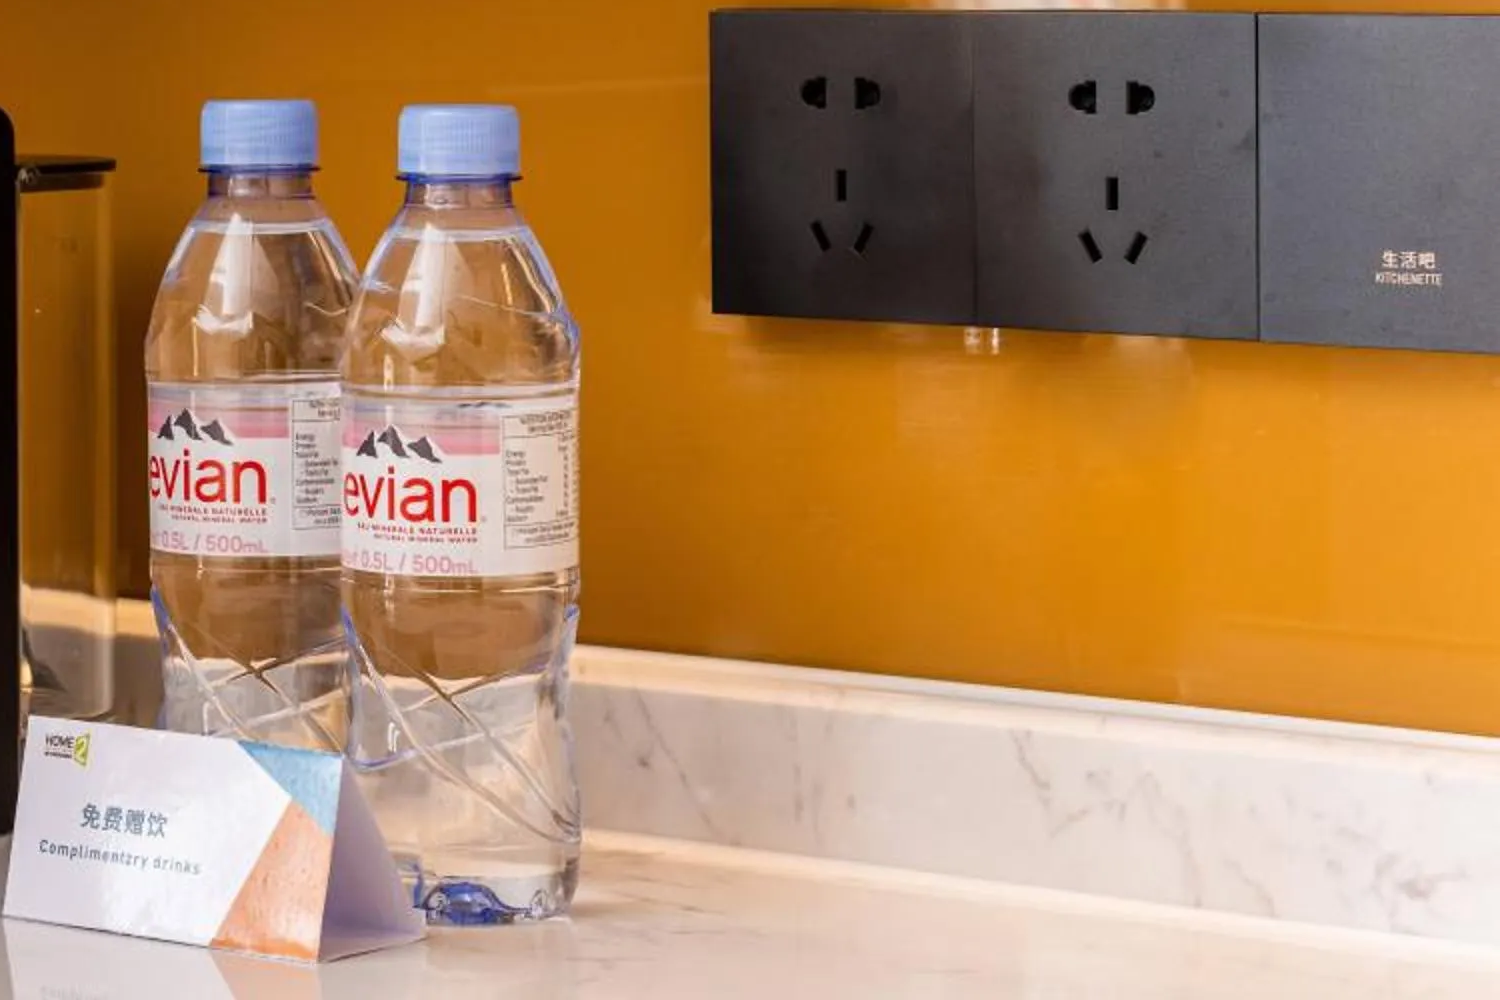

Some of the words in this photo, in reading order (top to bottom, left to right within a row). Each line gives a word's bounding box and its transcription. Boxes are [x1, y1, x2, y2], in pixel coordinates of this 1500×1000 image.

[1381, 250, 1436, 269] 生活吧
[1375, 272, 1443, 285] KITCHENETTE
[149, 448, 267, 504] evian
[343, 465, 477, 522] evian
[211, 506, 267, 516] NATURELLE
[419, 527, 477, 535] NATURELLE
[206, 534, 269, 553] 500mL
[361, 551, 393, 571] 0.5L
[412, 553, 478, 573] 500mL
[45, 734, 74, 749] HOME
[80, 803, 168, 837] 免费赠饮
[153, 856, 201, 875] drinks
